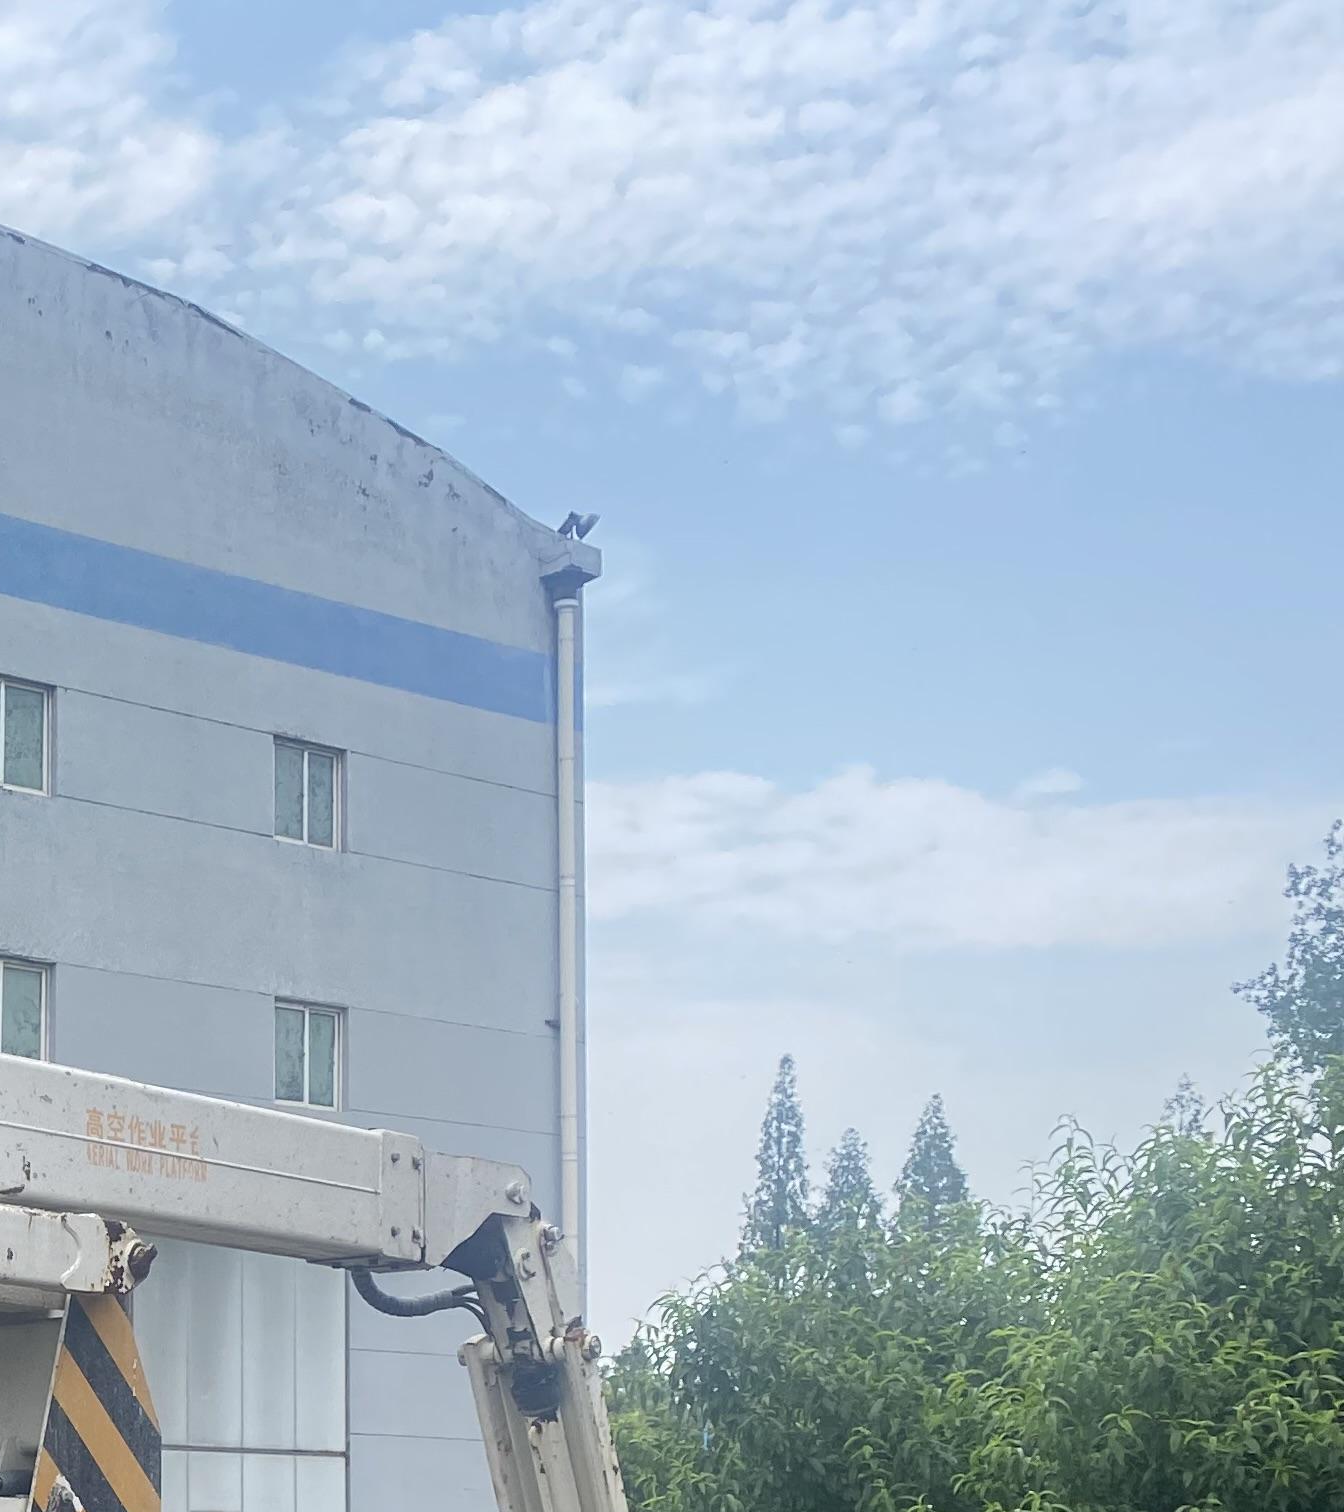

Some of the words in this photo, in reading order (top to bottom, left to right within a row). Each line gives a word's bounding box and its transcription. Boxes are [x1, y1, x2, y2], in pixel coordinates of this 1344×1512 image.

[85, 1106, 200, 1156] 高空作业平台
